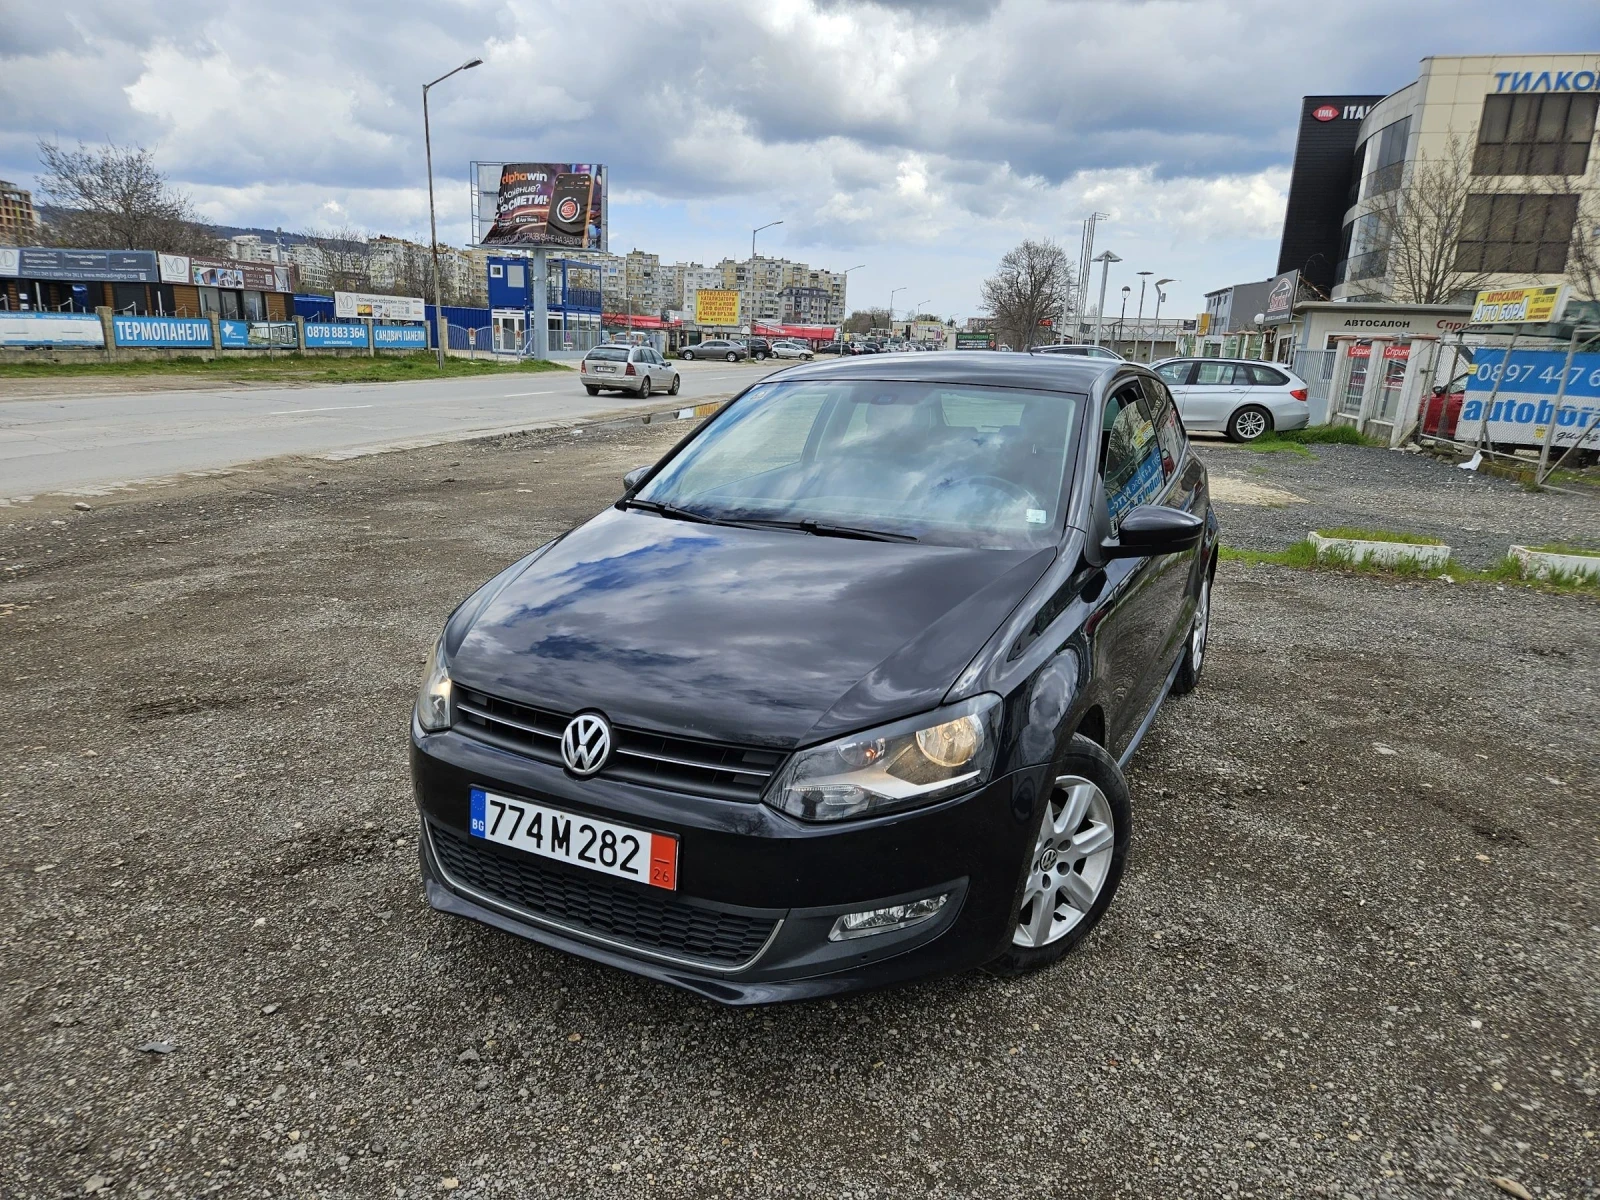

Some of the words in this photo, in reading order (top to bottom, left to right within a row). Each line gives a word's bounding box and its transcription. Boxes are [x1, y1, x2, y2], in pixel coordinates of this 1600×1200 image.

[1494, 70, 1600, 92] ТИЛКО
[1318, 109, 1333, 118] IML
[1486, 290, 1524, 303] АВТОСАЛОН
[1344, 319, 1410, 328] АВТОСАЛОН
[116, 321, 209, 341] ТЕРМОПАНЕЛИ
[307, 326, 330, 338] 0878
[332, 326, 348, 338] 883
[350, 328, 365, 338] 364
[375, 330, 402, 342] САНДВИЧ
[403, 330, 425, 341] ПАНЕЛИ
[1351, 347, 1371, 356] Сприн
[1477, 364, 1535, 383] 0897
[1538, 366, 1586, 385] 447
[472, 818, 484, 831] BG
[653, 868, 669, 883] 26
